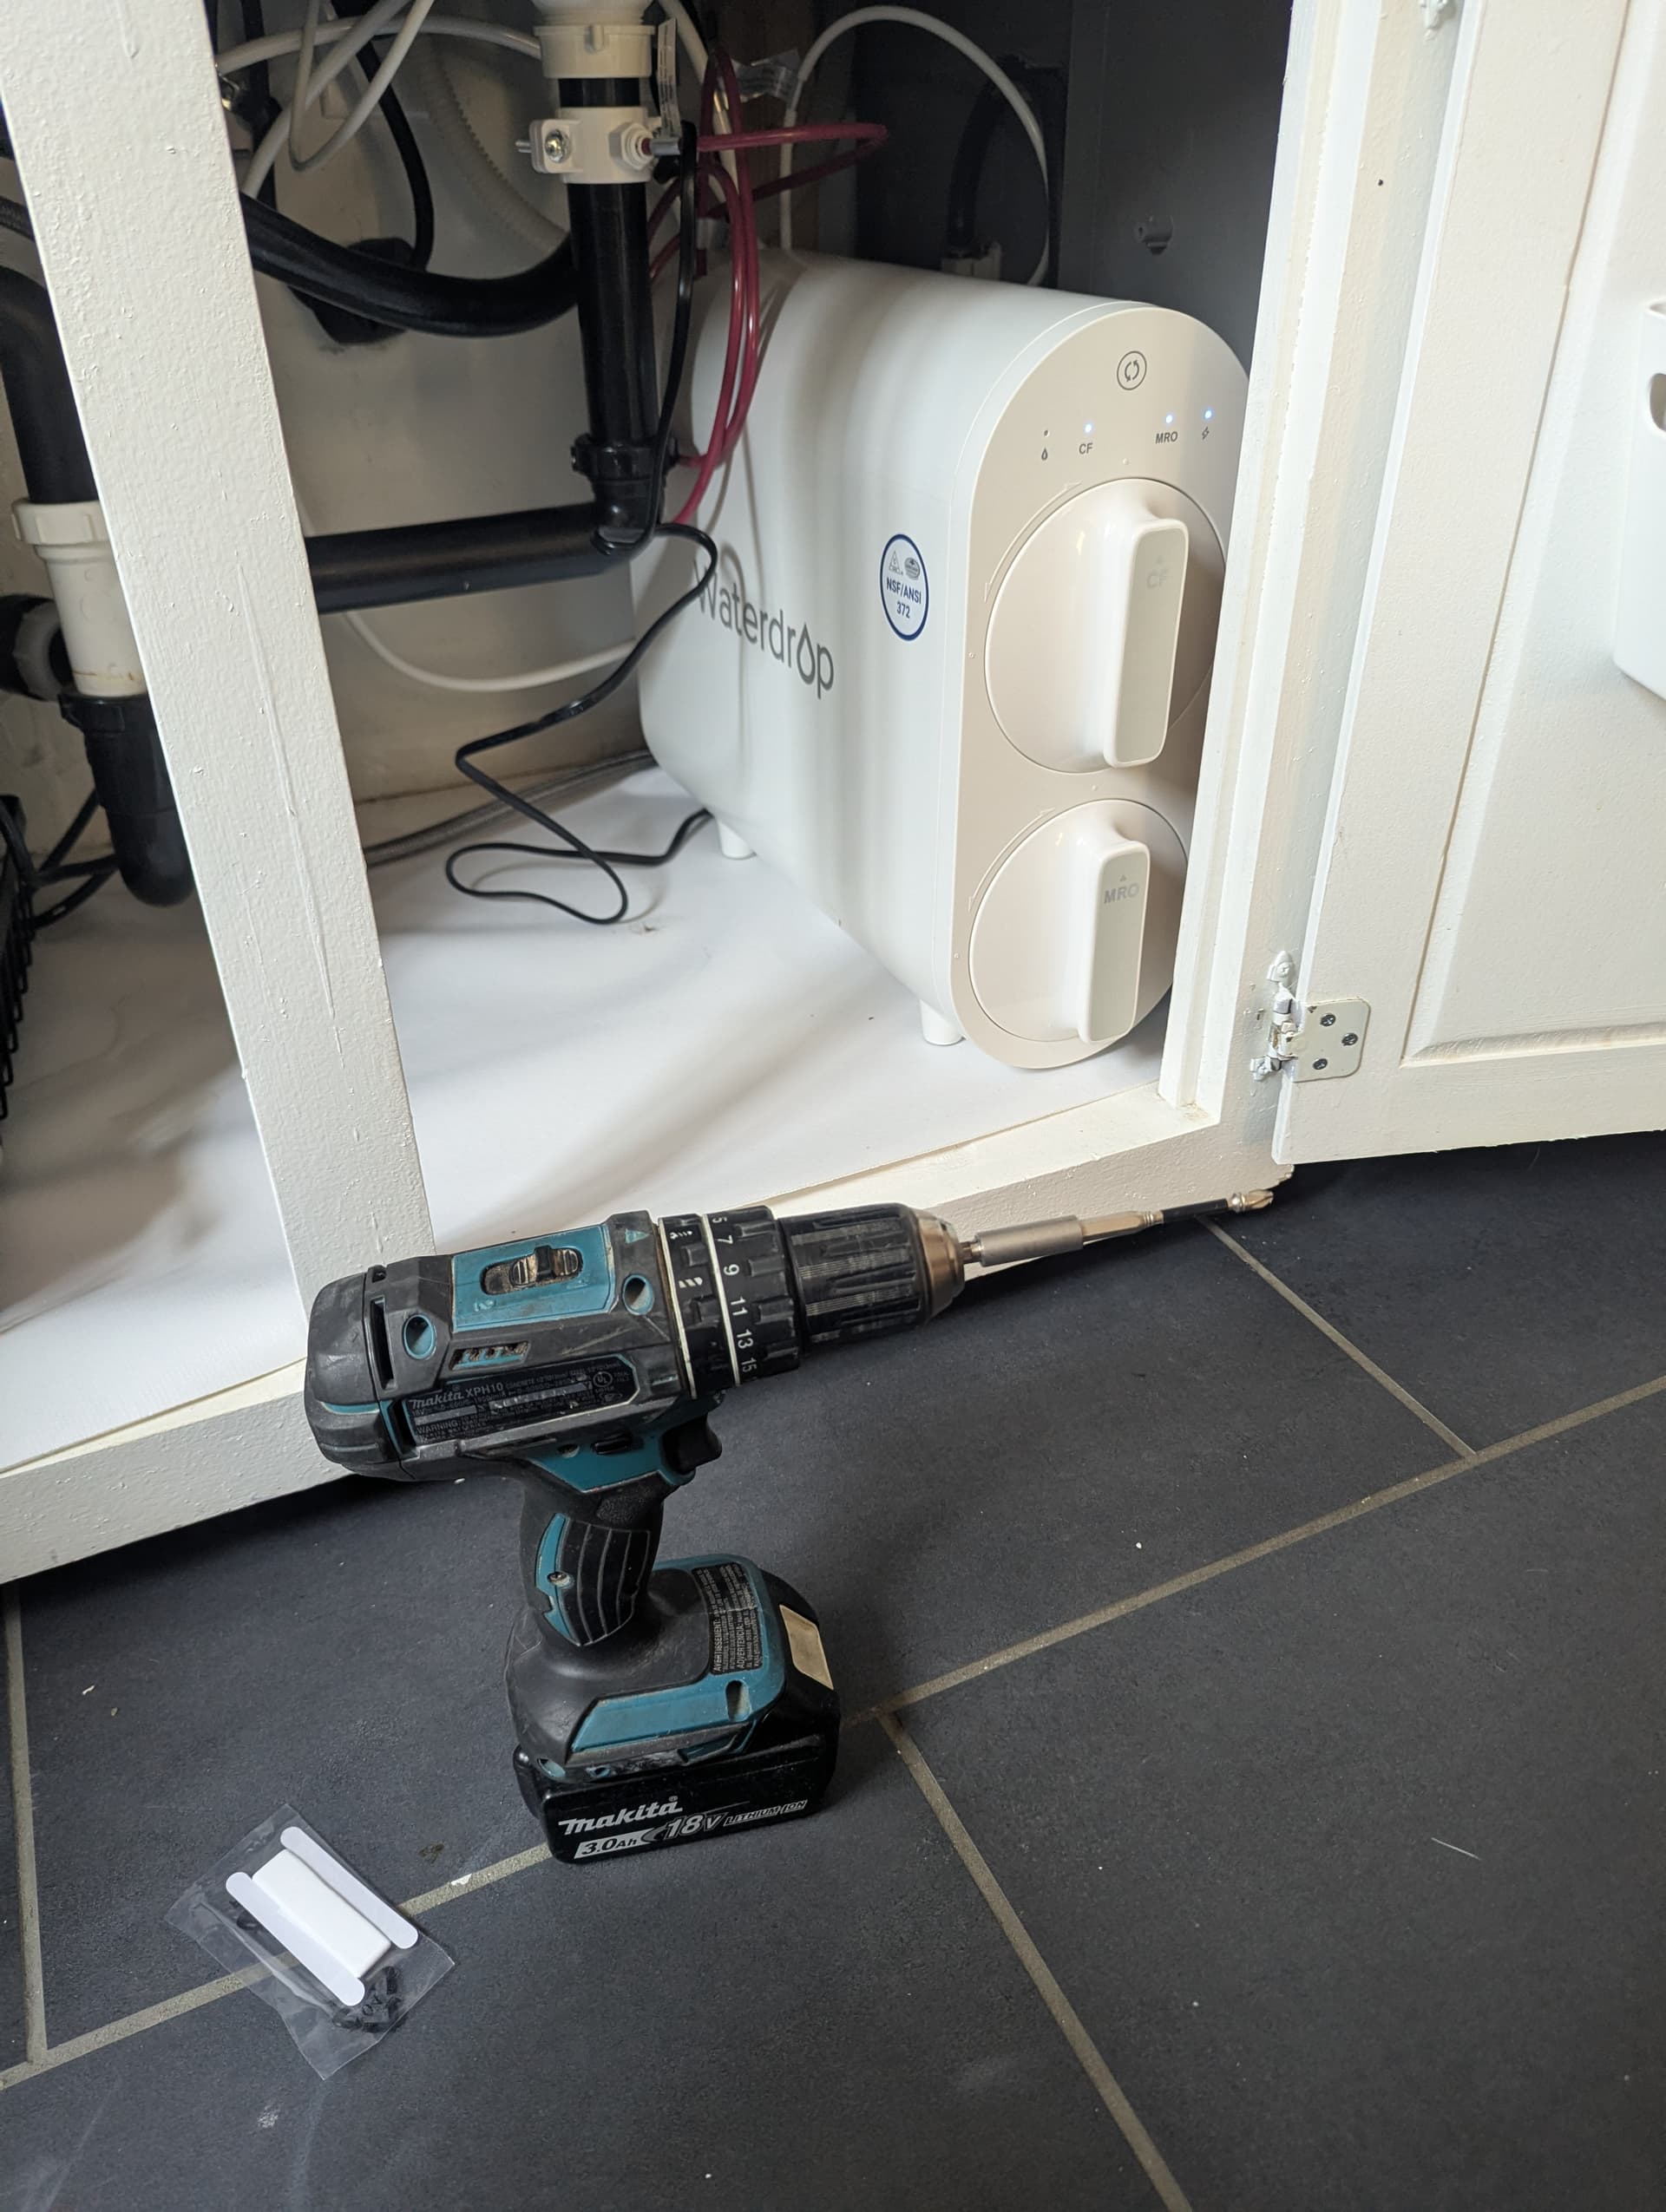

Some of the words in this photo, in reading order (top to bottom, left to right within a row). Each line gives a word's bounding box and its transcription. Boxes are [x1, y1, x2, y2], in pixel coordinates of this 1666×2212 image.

[1155, 430, 1178, 444] MRO
[1079, 442, 1093, 455] CF
[886, 577, 922, 604] NSF/ANSI
[896, 601, 910, 618] 372
[1103, 882, 1139, 904] MRO
[715, 1234, 733, 1244] 7
[723, 1264, 740, 1276] 9
[731, 1296, 748, 1316] 11
[737, 1329, 754, 1349] 13
[741, 1357, 758, 1372] 15
[465, 1382, 503, 1398] XPH10
[580, 1837, 638, 1855] 3.0Ah
[665, 1814, 727, 1840] 18V
